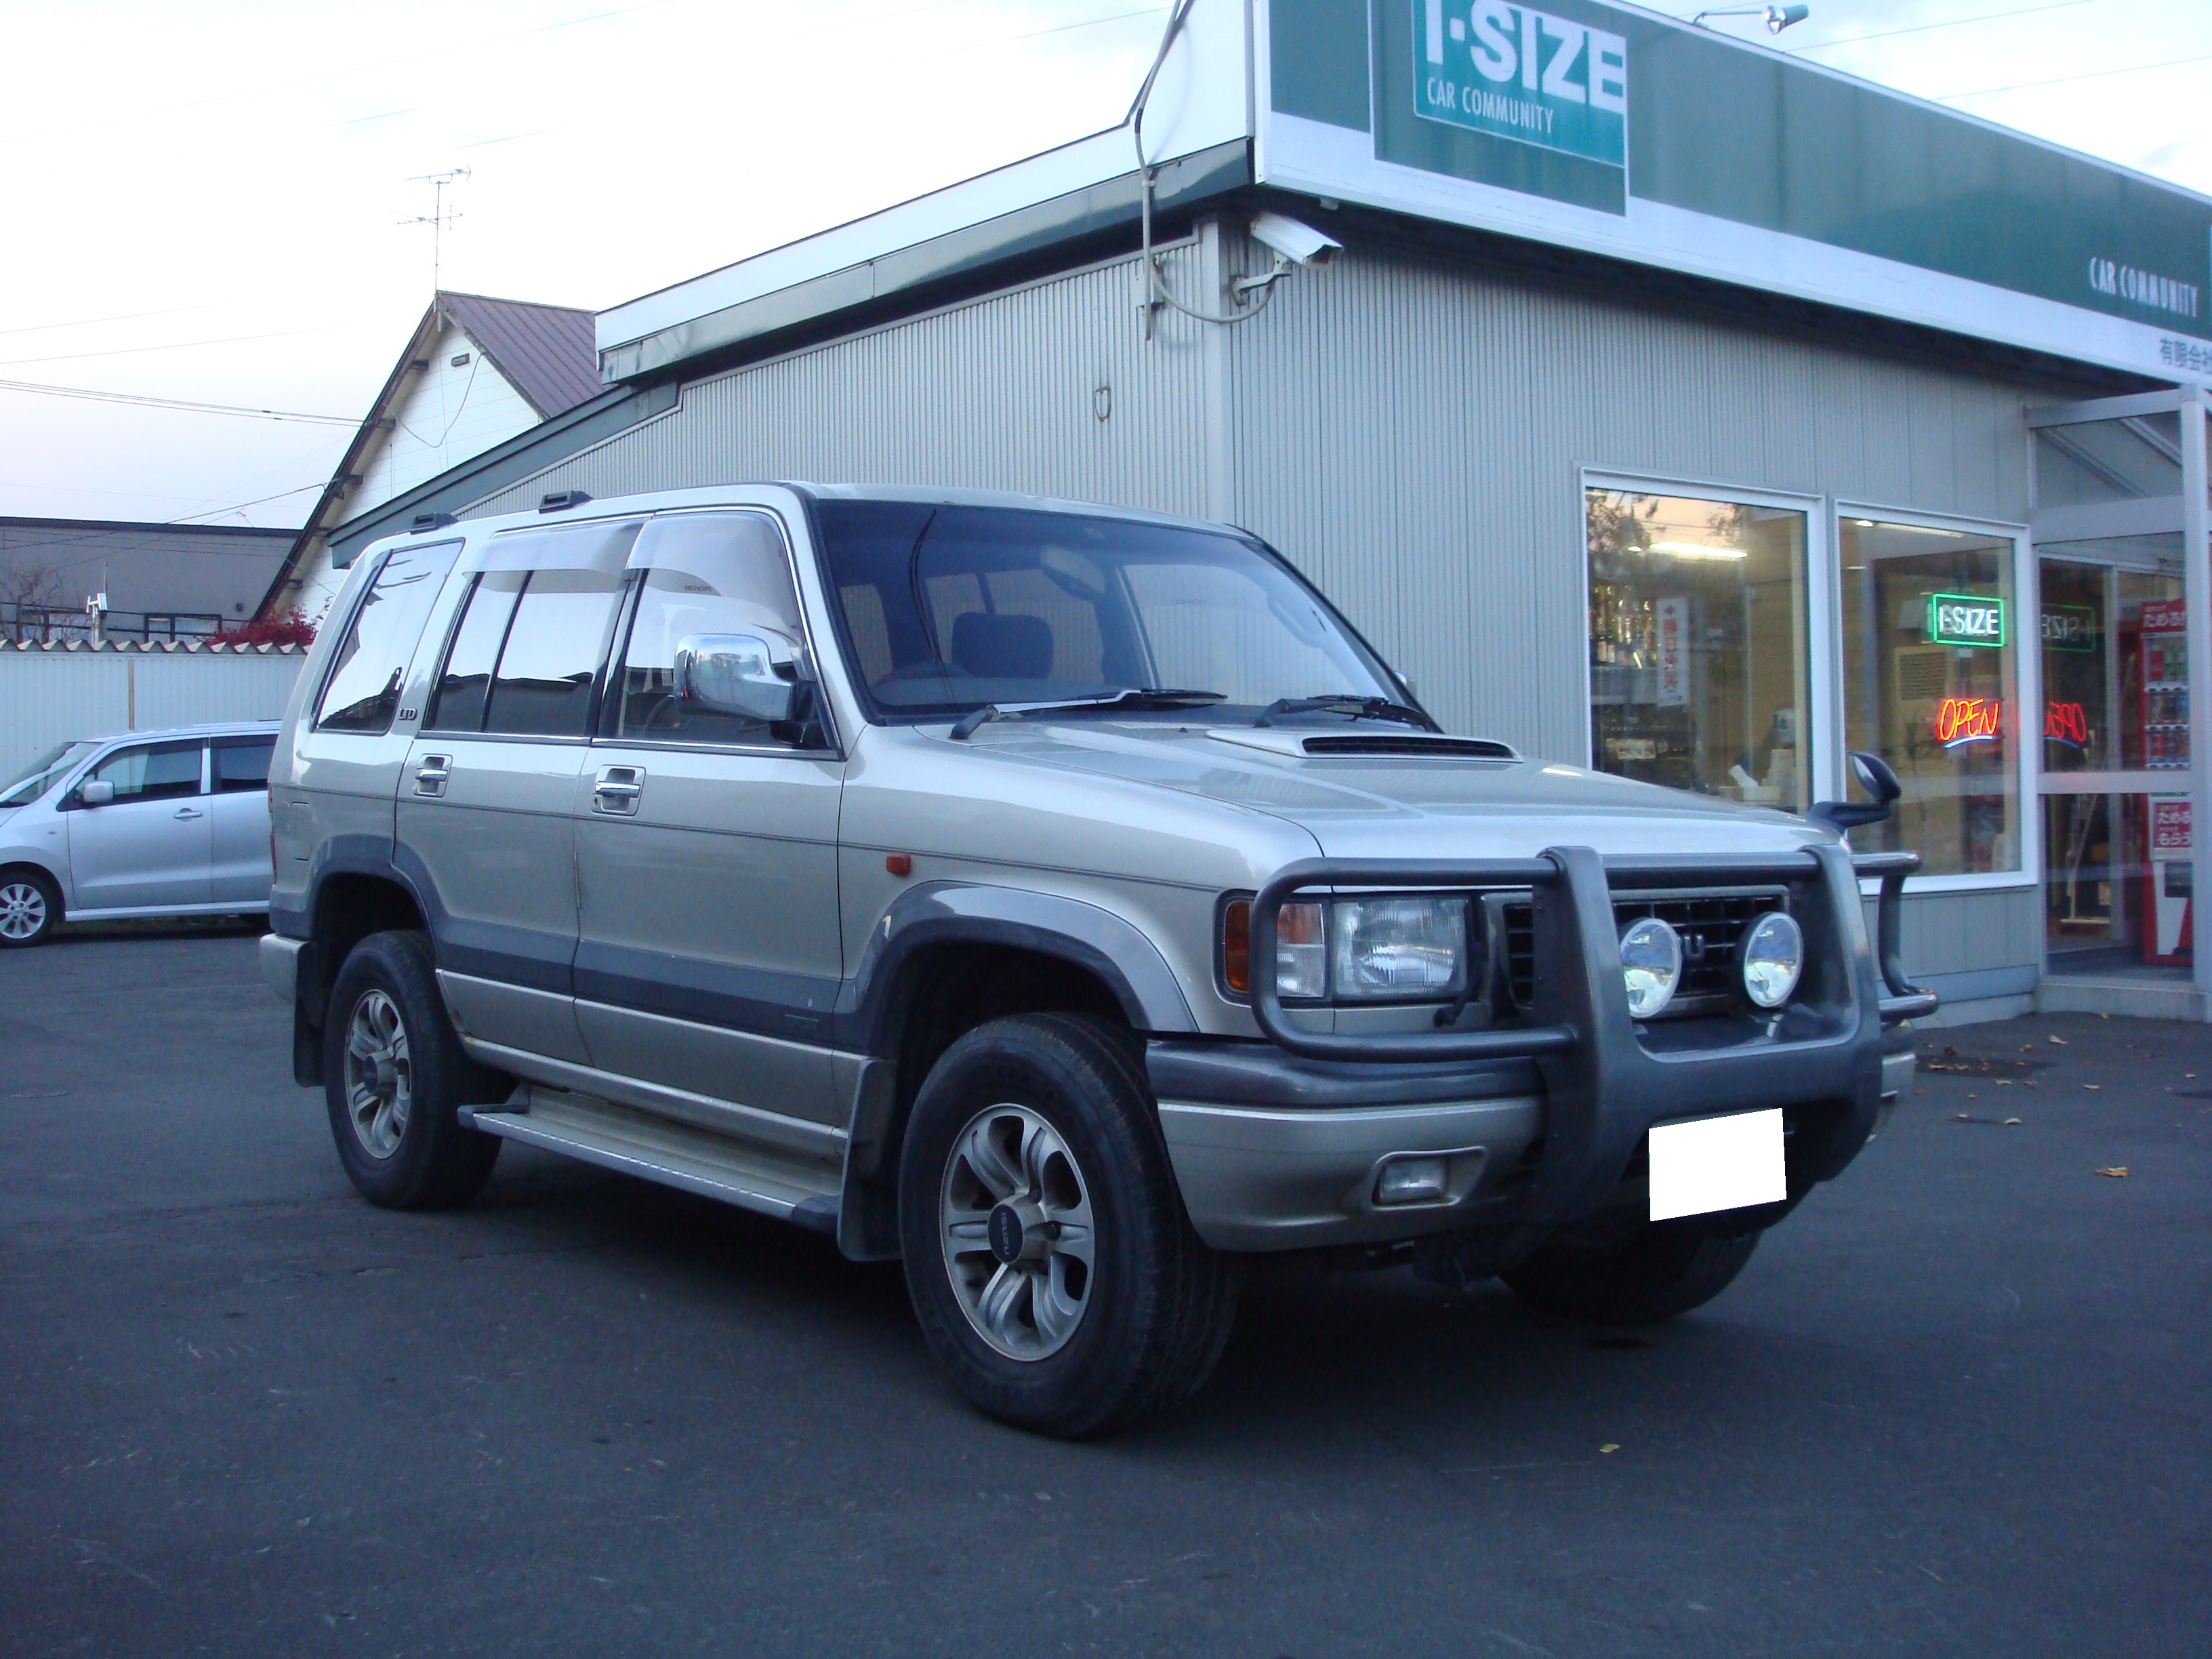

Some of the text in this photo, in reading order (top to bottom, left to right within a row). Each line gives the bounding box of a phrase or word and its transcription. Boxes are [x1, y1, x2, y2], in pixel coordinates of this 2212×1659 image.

[1427, 77, 1554, 134] CAR COMMUNITY
[2089, 257, 2198, 318] CAR COMMUNITY
[1938, 697, 1999, 741] OPEN
[1001, 1212, 1010, 1255] ISUZU
